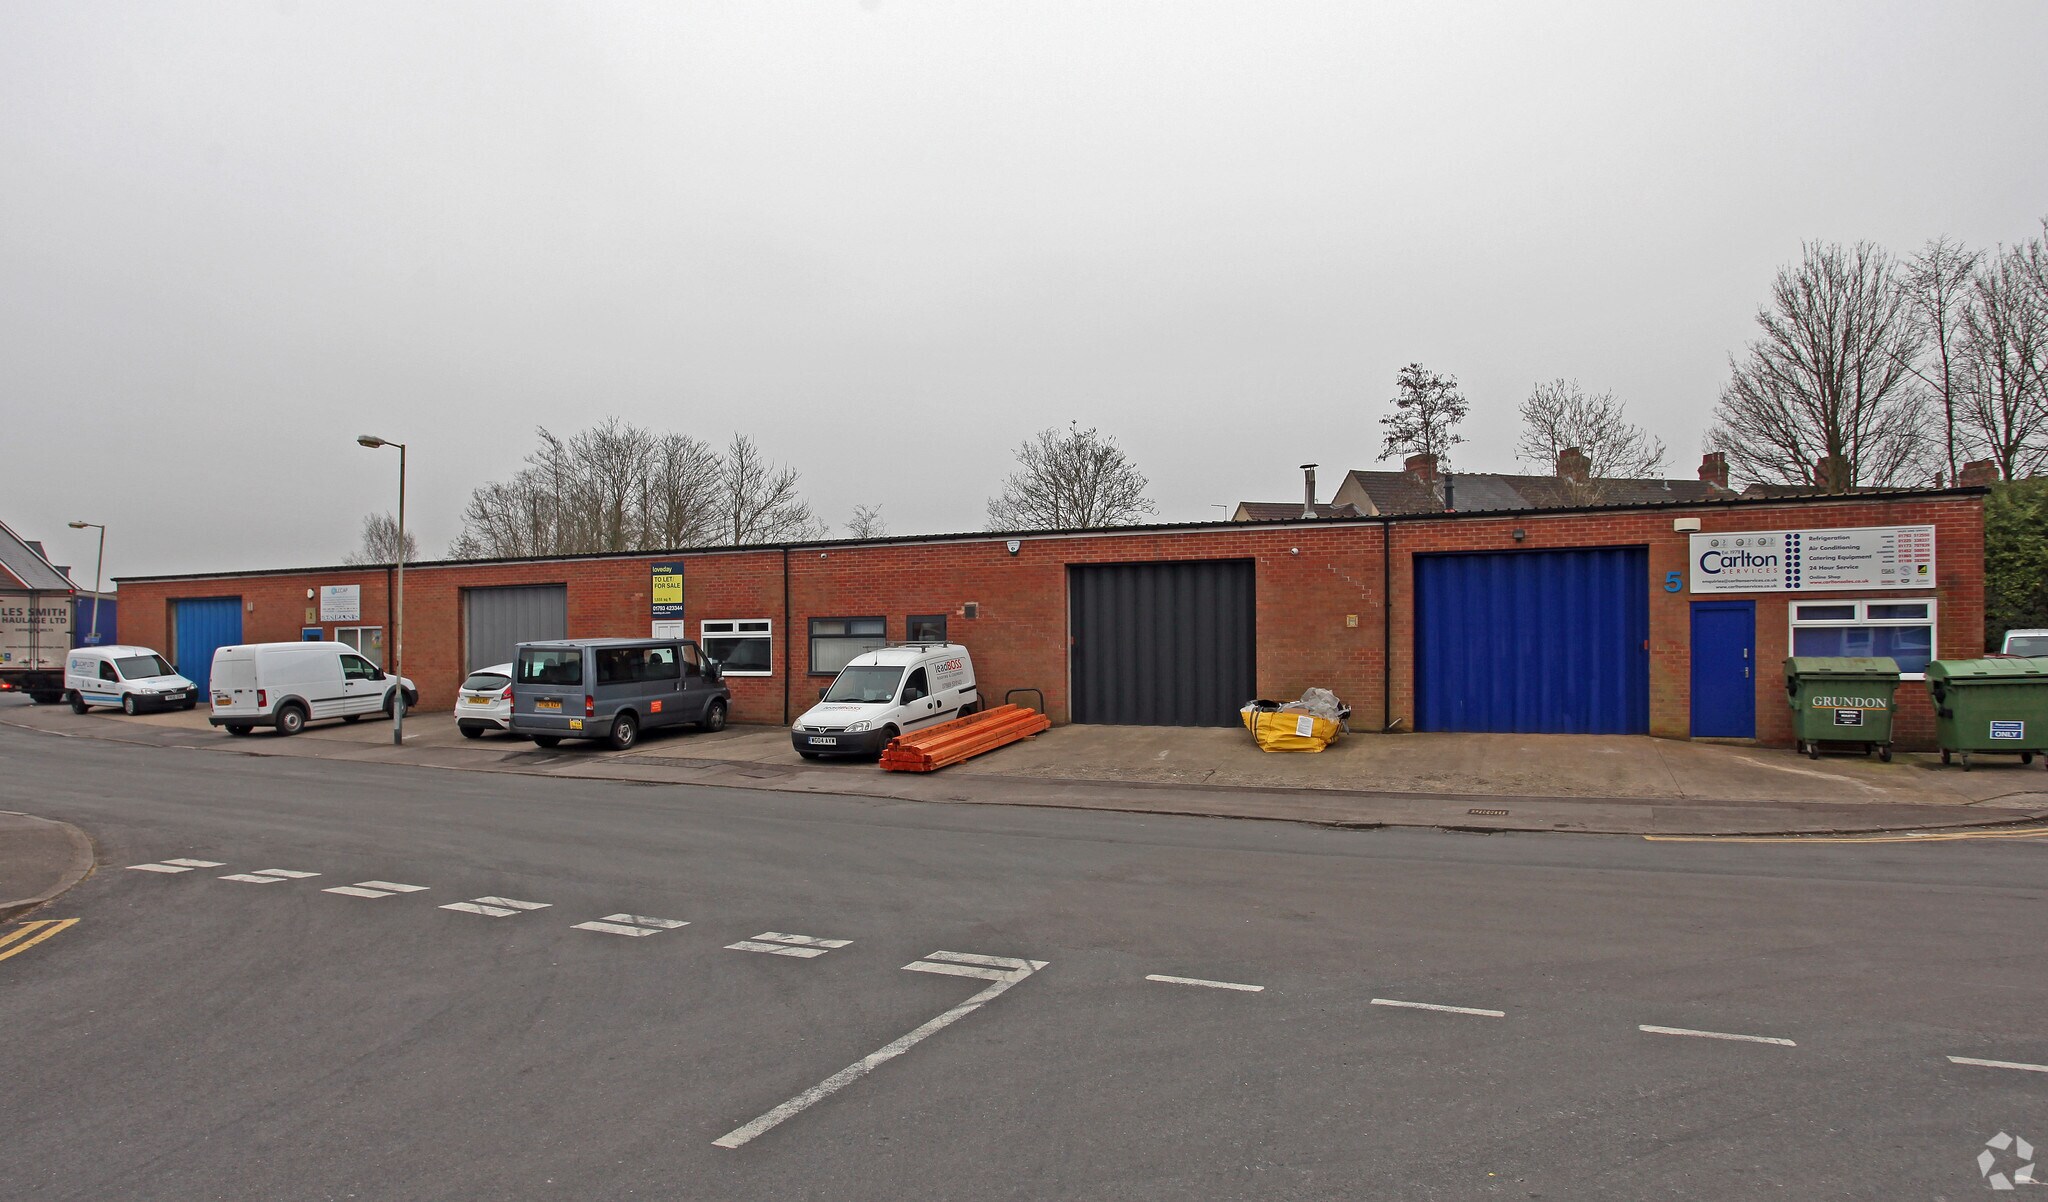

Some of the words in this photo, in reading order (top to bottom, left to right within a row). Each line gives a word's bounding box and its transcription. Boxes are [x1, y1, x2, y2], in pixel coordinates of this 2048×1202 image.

[1700, 550, 1778, 574] Carlton
[1664, 571, 1683, 593] 5
[1, 607, 23, 616] LES
[28, 608, 67, 616] SMITH
[935, 659, 962, 673] leadBOSS
[1812, 696, 1887, 708] GRUNDON
